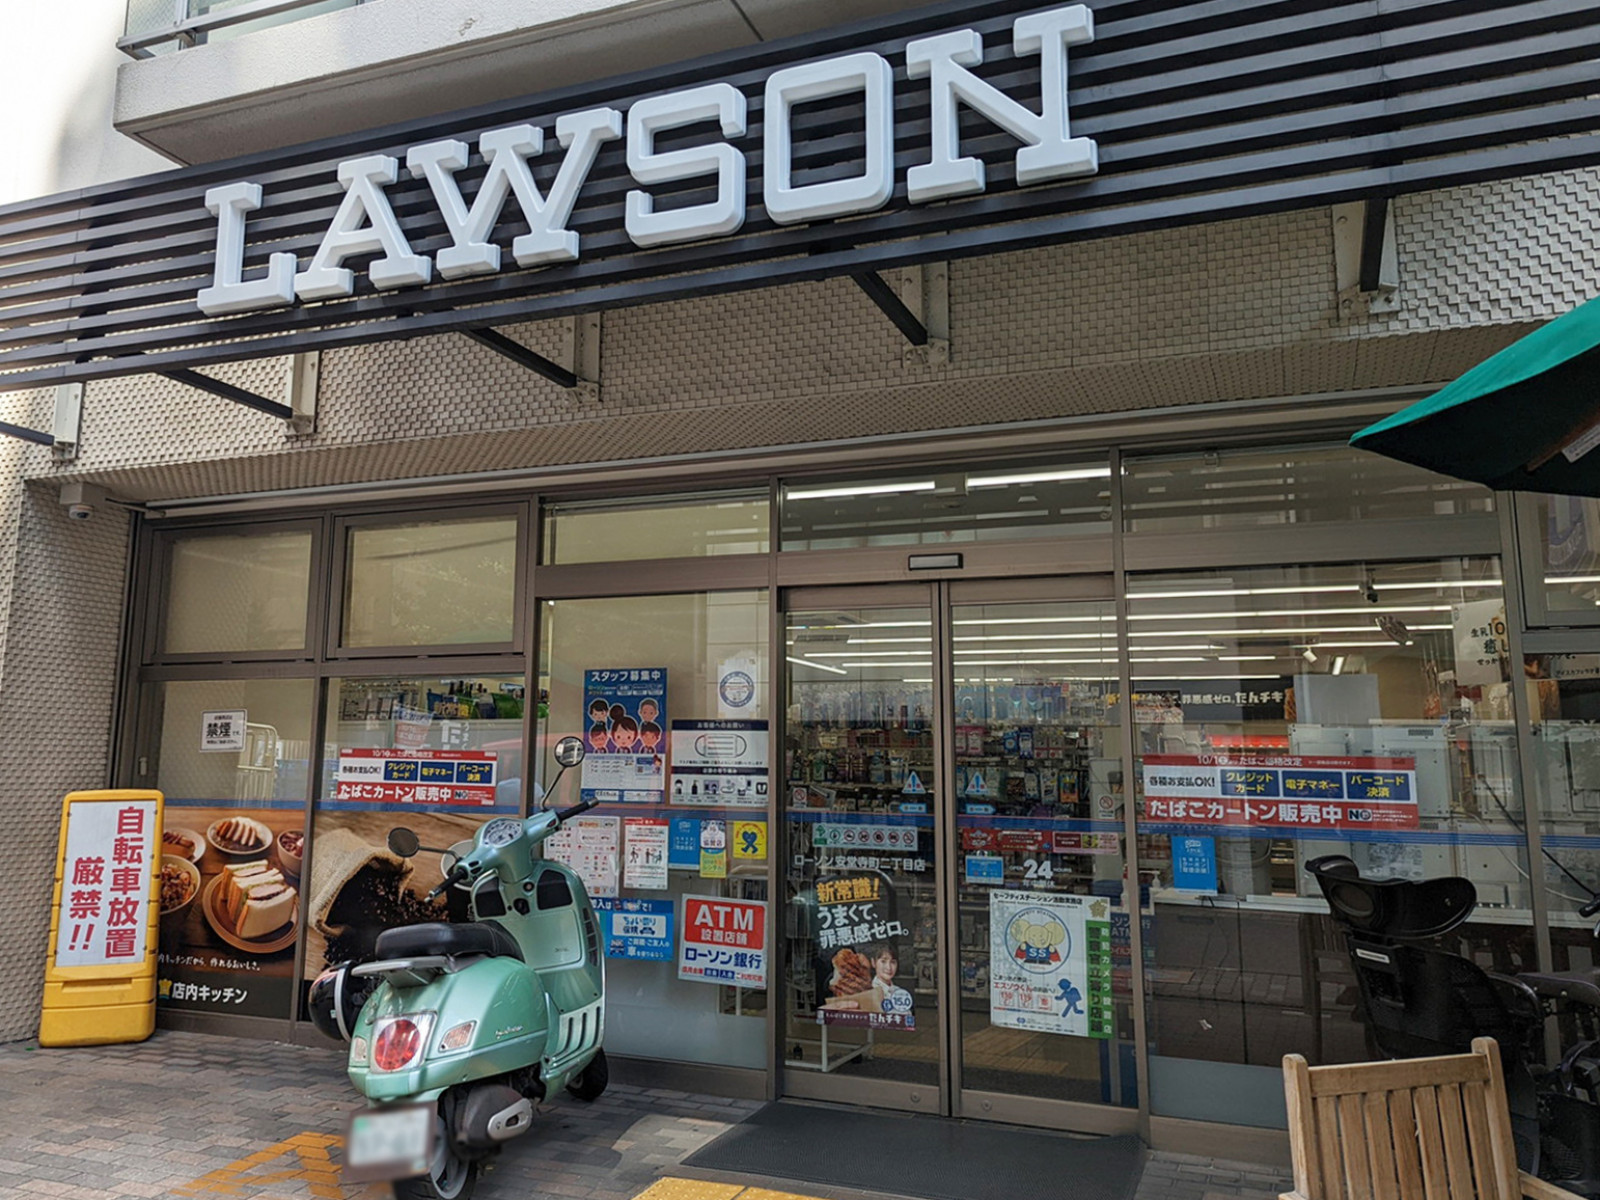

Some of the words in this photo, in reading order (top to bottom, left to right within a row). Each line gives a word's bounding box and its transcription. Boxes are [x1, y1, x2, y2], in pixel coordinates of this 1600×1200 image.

[196, 4, 1099, 317] LAWSON
[591, 670, 661, 682] スタッフ募集中
[206, 722, 231, 737] 禁煙
[421, 768, 453, 777] 電子マネー
[1226, 772, 1273, 783] クレジット
[1351, 775, 1405, 786] バーコード
[339, 783, 452, 802] たばこカートン販売中
[1235, 784, 1265, 794] カード
[1285, 779, 1340, 790] 電子マネー
[1366, 787, 1390, 797] 決済
[1150, 799, 1343, 824] たばこカートン販売中
[794, 854, 926, 872] ローソン安堂寺町二丁目店
[1023, 858, 1053, 879] 24
[105, 806, 144, 959] 自転車放置
[68, 856, 105, 951] 厳禁!!
[694, 904, 753, 931] ATM
[817, 903, 879, 929] うまくて、
[701, 928, 748, 945] 設置店舗
[819, 920, 909, 949] 罪悪感ゼロ。
[685, 947, 762, 969] ローソン銀行
[1029, 948, 1046, 957] SS
[172, 982, 247, 1004] 店内キッチン
